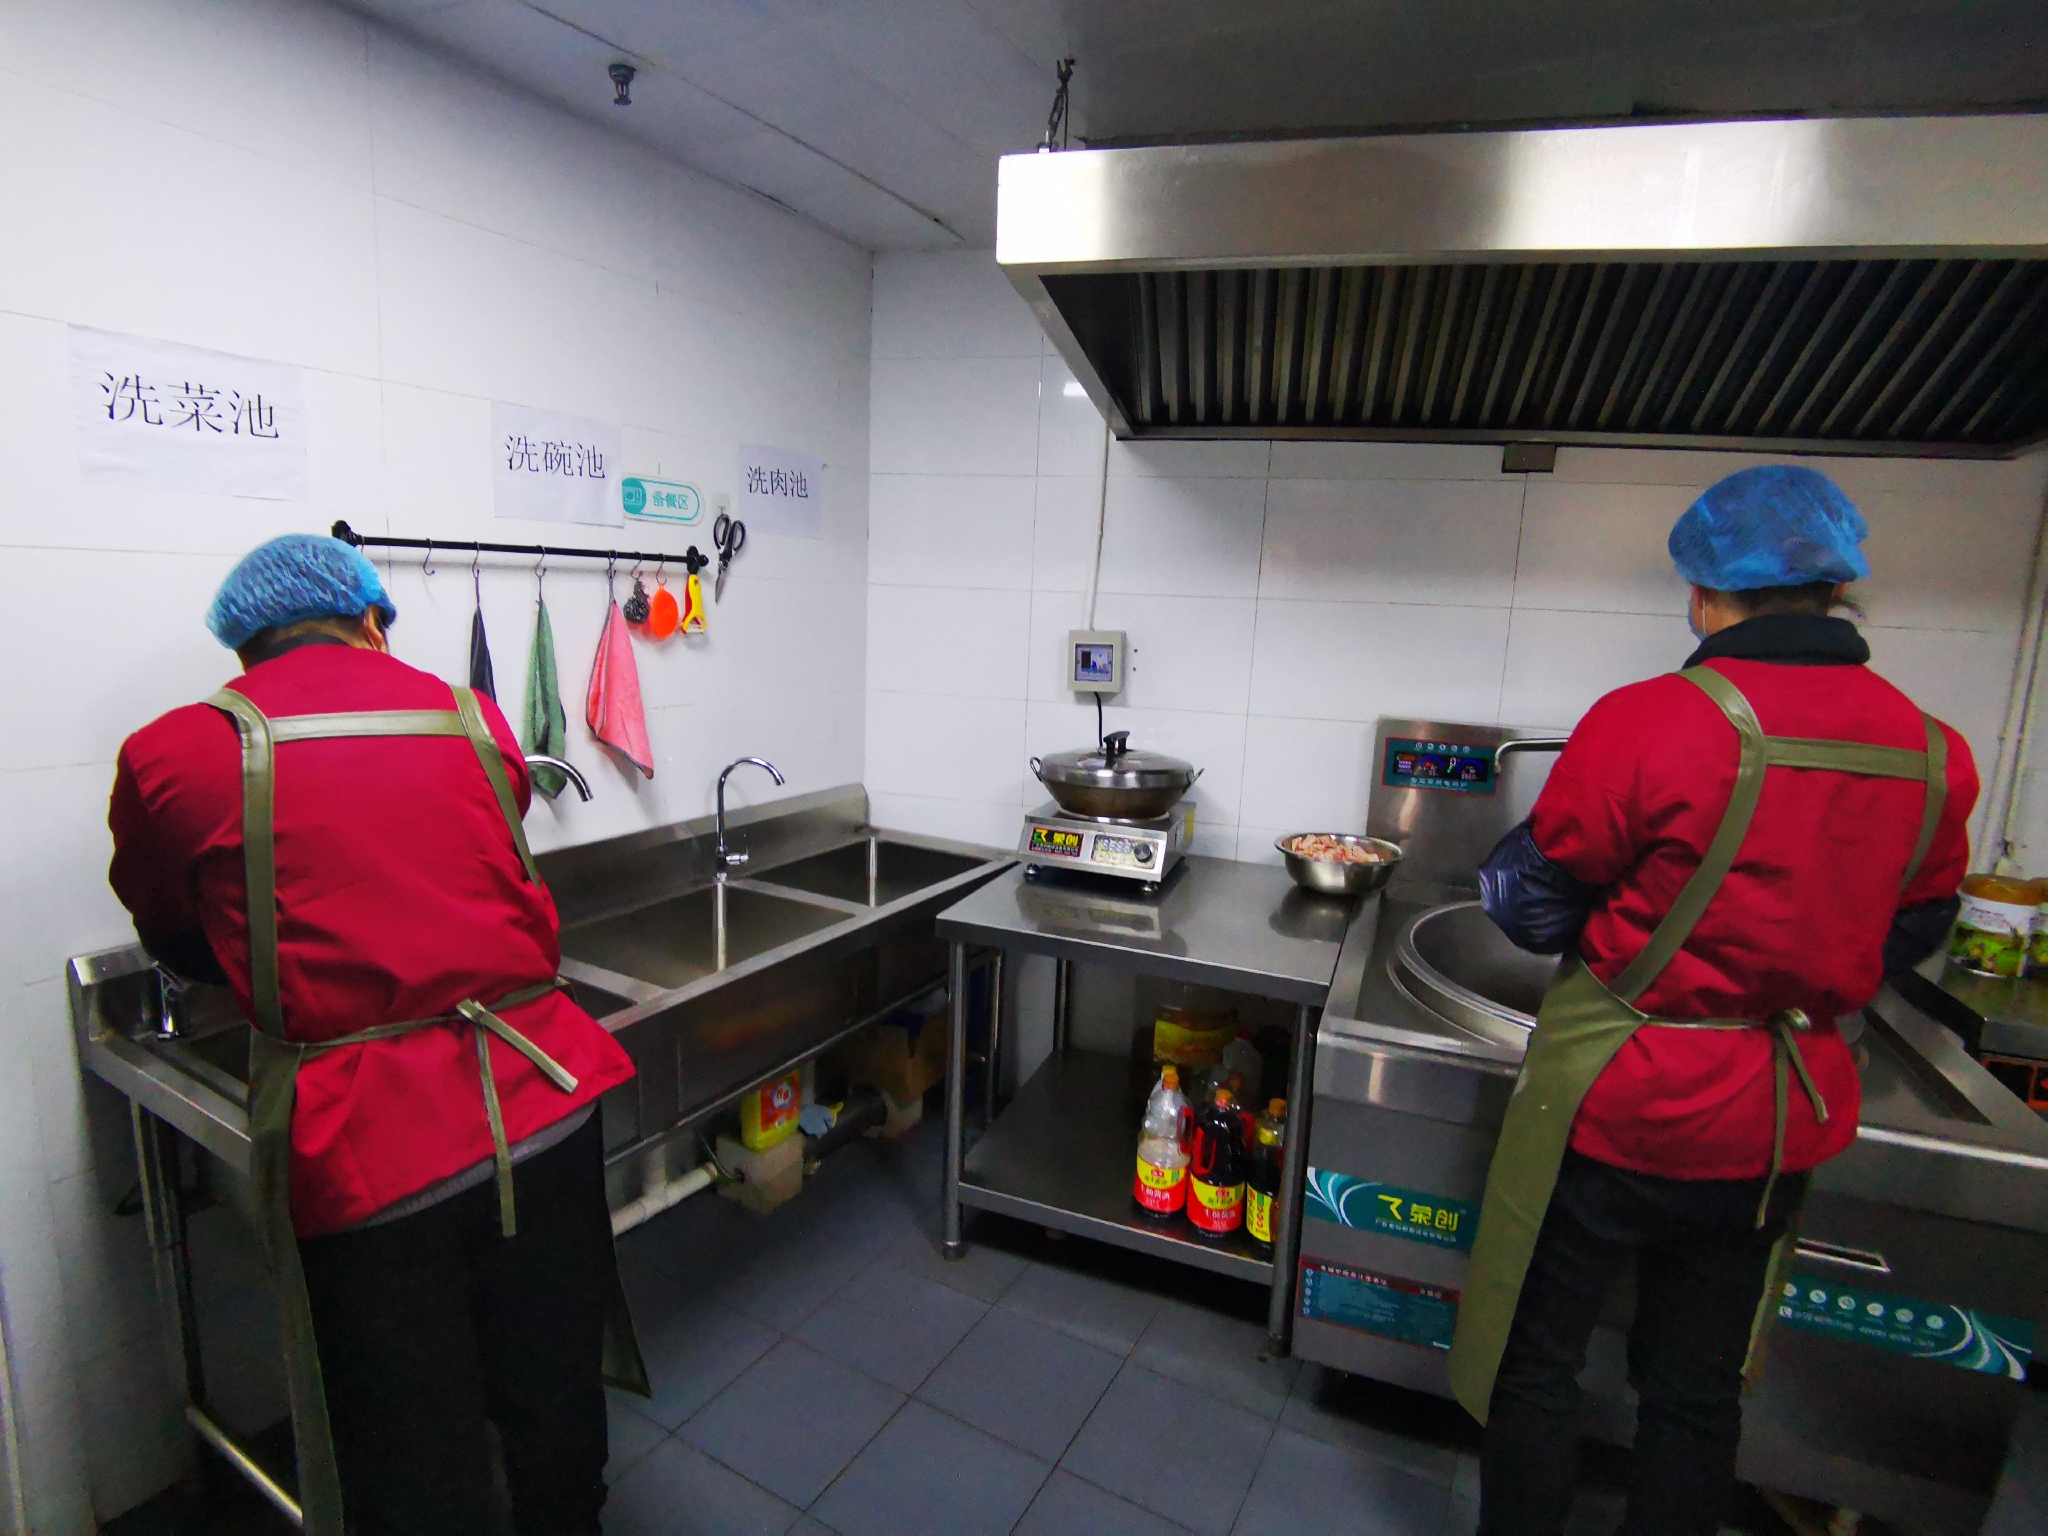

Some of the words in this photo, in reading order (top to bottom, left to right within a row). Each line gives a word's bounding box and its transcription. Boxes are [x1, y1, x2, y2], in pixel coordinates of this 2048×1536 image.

[98, 371, 279, 439] 洗菜池
[505, 435, 606, 479] 洗碗池
[747, 465, 809, 499] 洗肉池
[1409, 1202, 1460, 1232] 荣创
